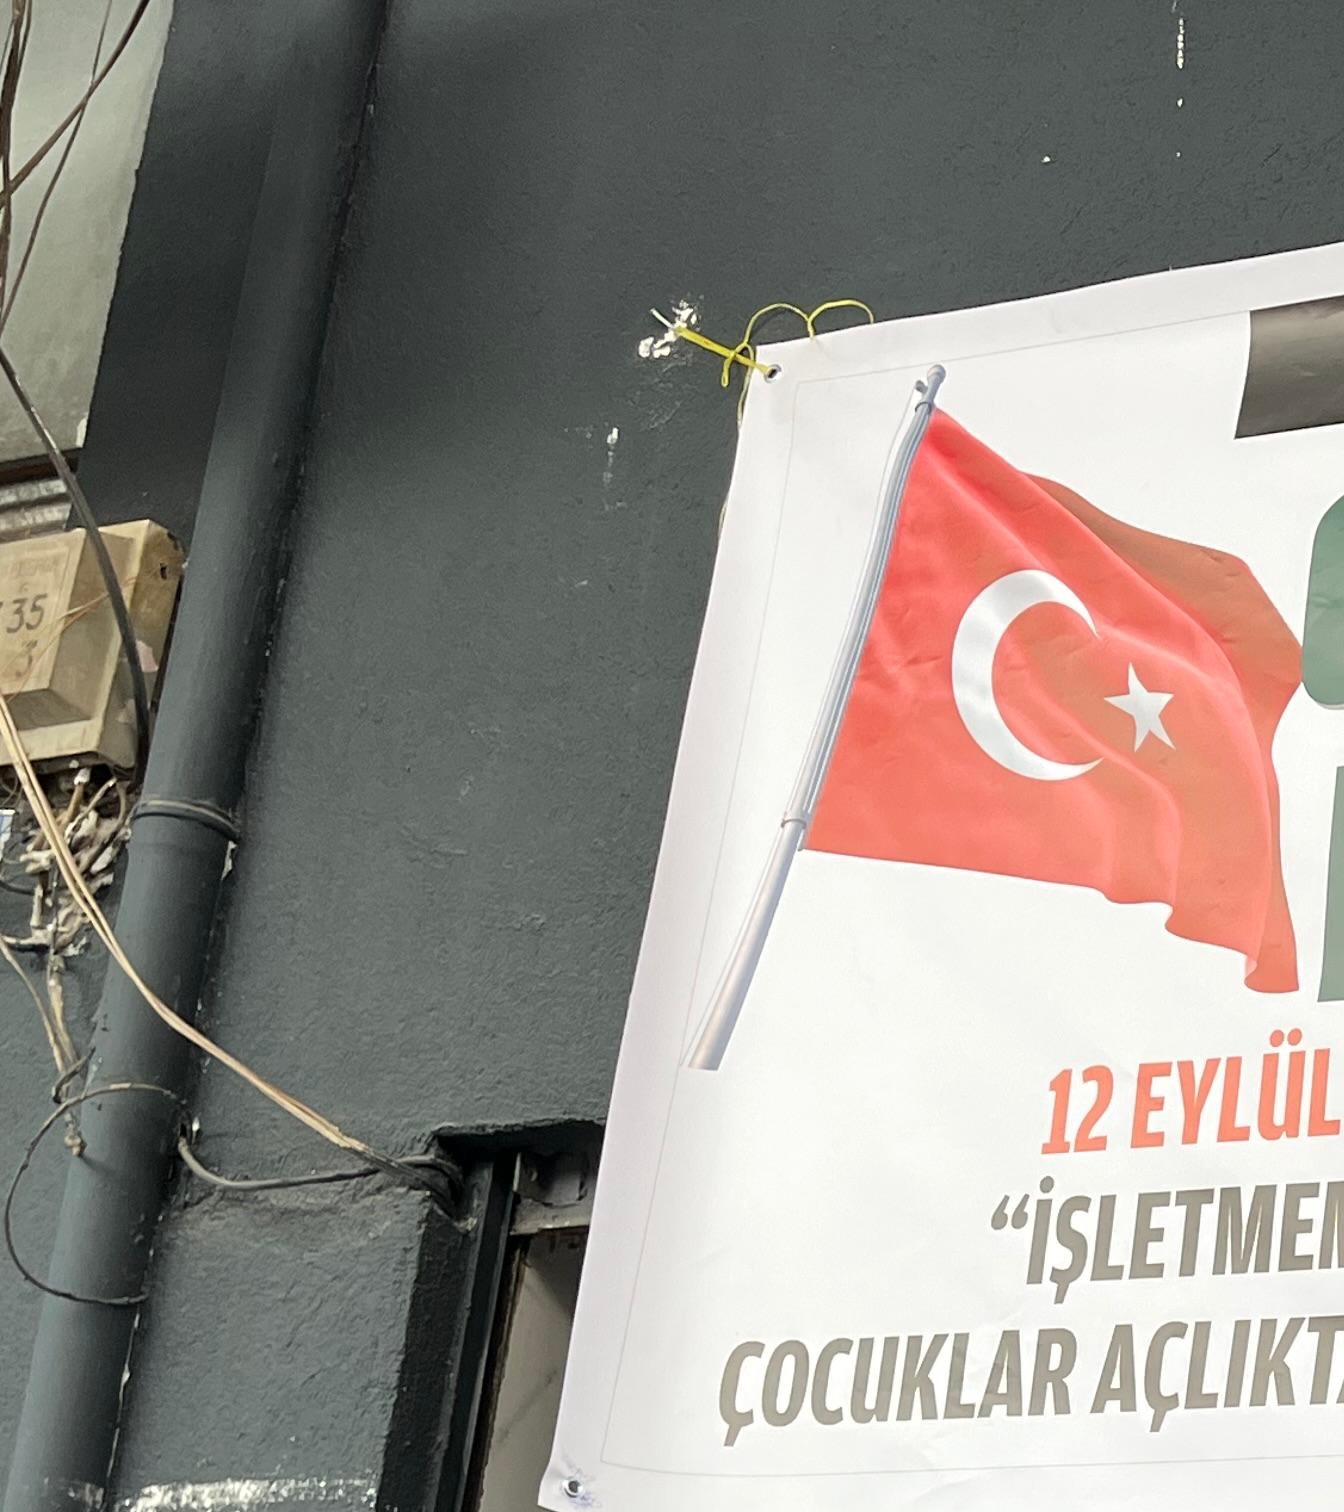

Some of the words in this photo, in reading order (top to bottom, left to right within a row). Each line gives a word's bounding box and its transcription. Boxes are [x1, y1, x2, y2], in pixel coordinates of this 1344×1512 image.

[0, 593, 47, 633] 35
[1040, 1065, 1108, 1155] 12
[1130, 1030, 1342, 1148] EYLÜL
[717, 1329, 1078, 1447] ÇOCUKLAR
